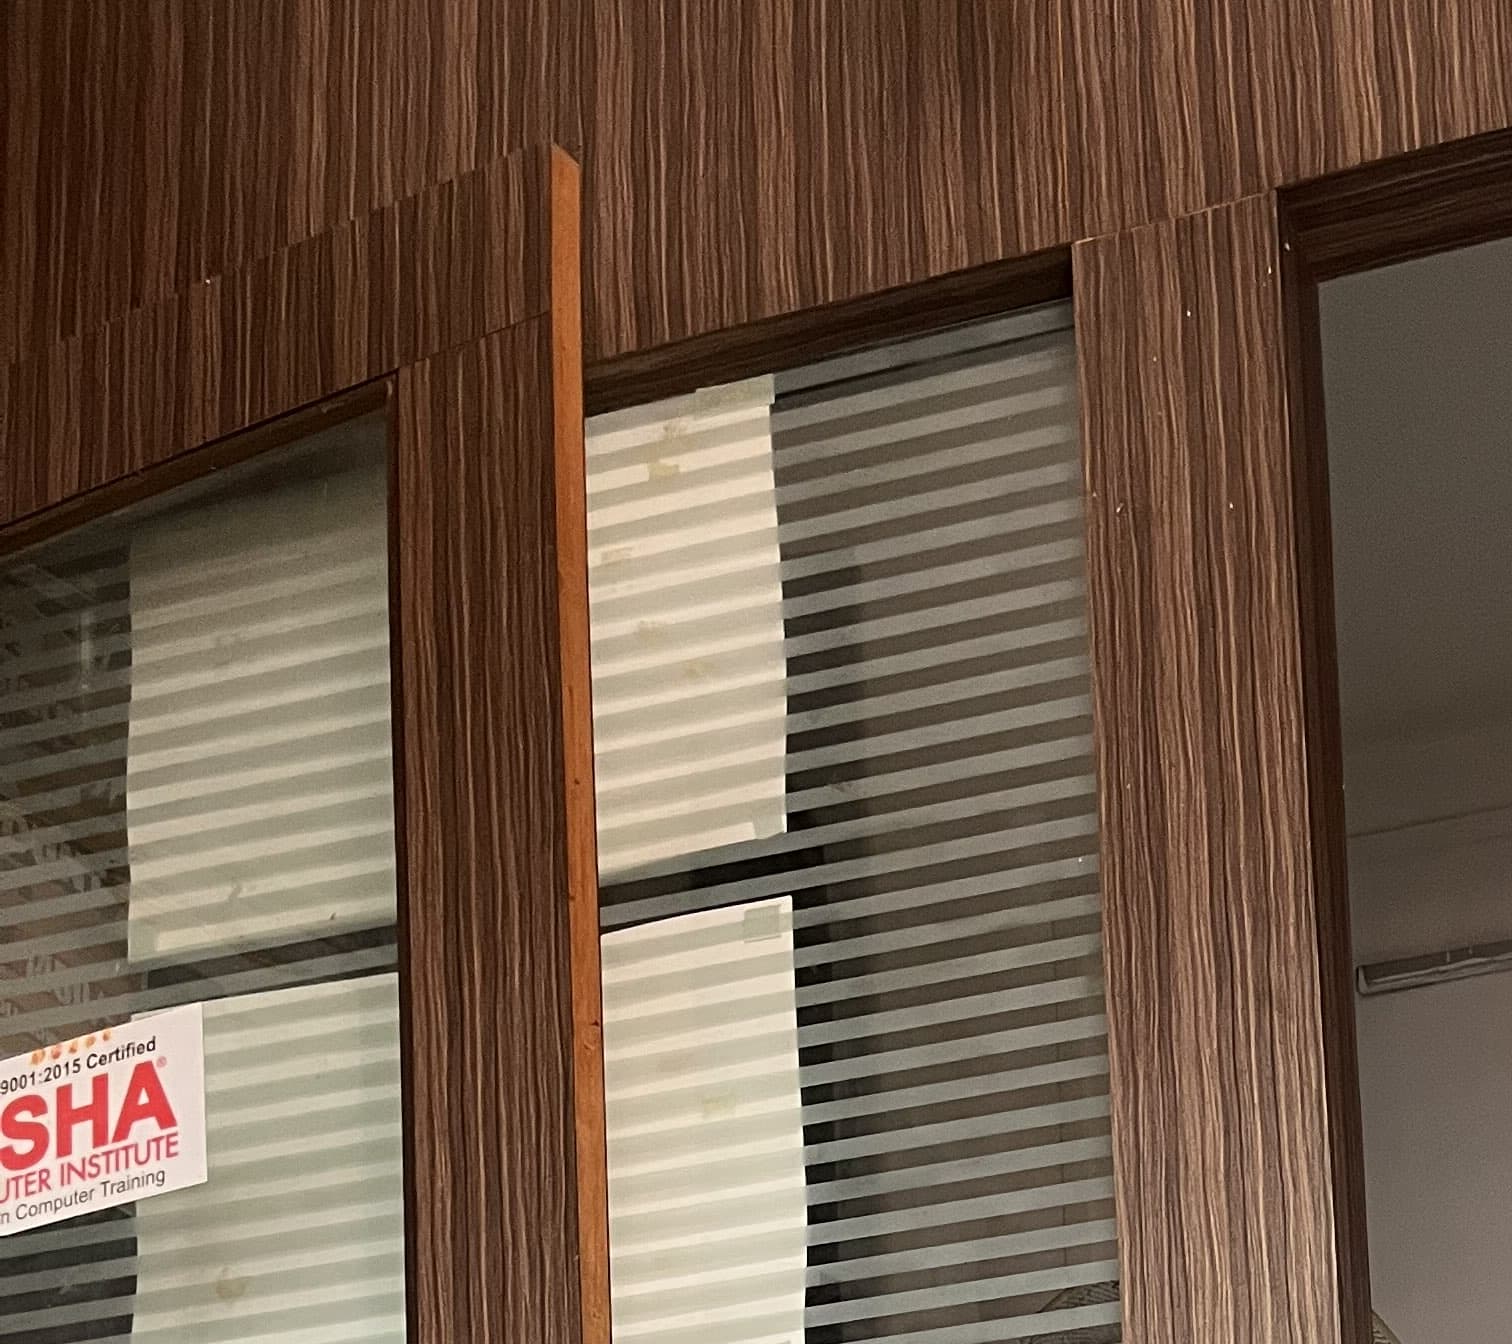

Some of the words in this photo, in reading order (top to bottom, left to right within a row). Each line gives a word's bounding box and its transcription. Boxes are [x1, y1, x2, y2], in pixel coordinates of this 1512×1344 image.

[0, 1057, 81, 1095] 9001:2015
[86, 1035, 157, 1069] Certified
[0, 1060, 178, 1171] SHA
[60, 1132, 179, 1187] INSTITUTE
[15, 1187, 96, 1221] Computer
[100, 1169, 166, 1199] Training
